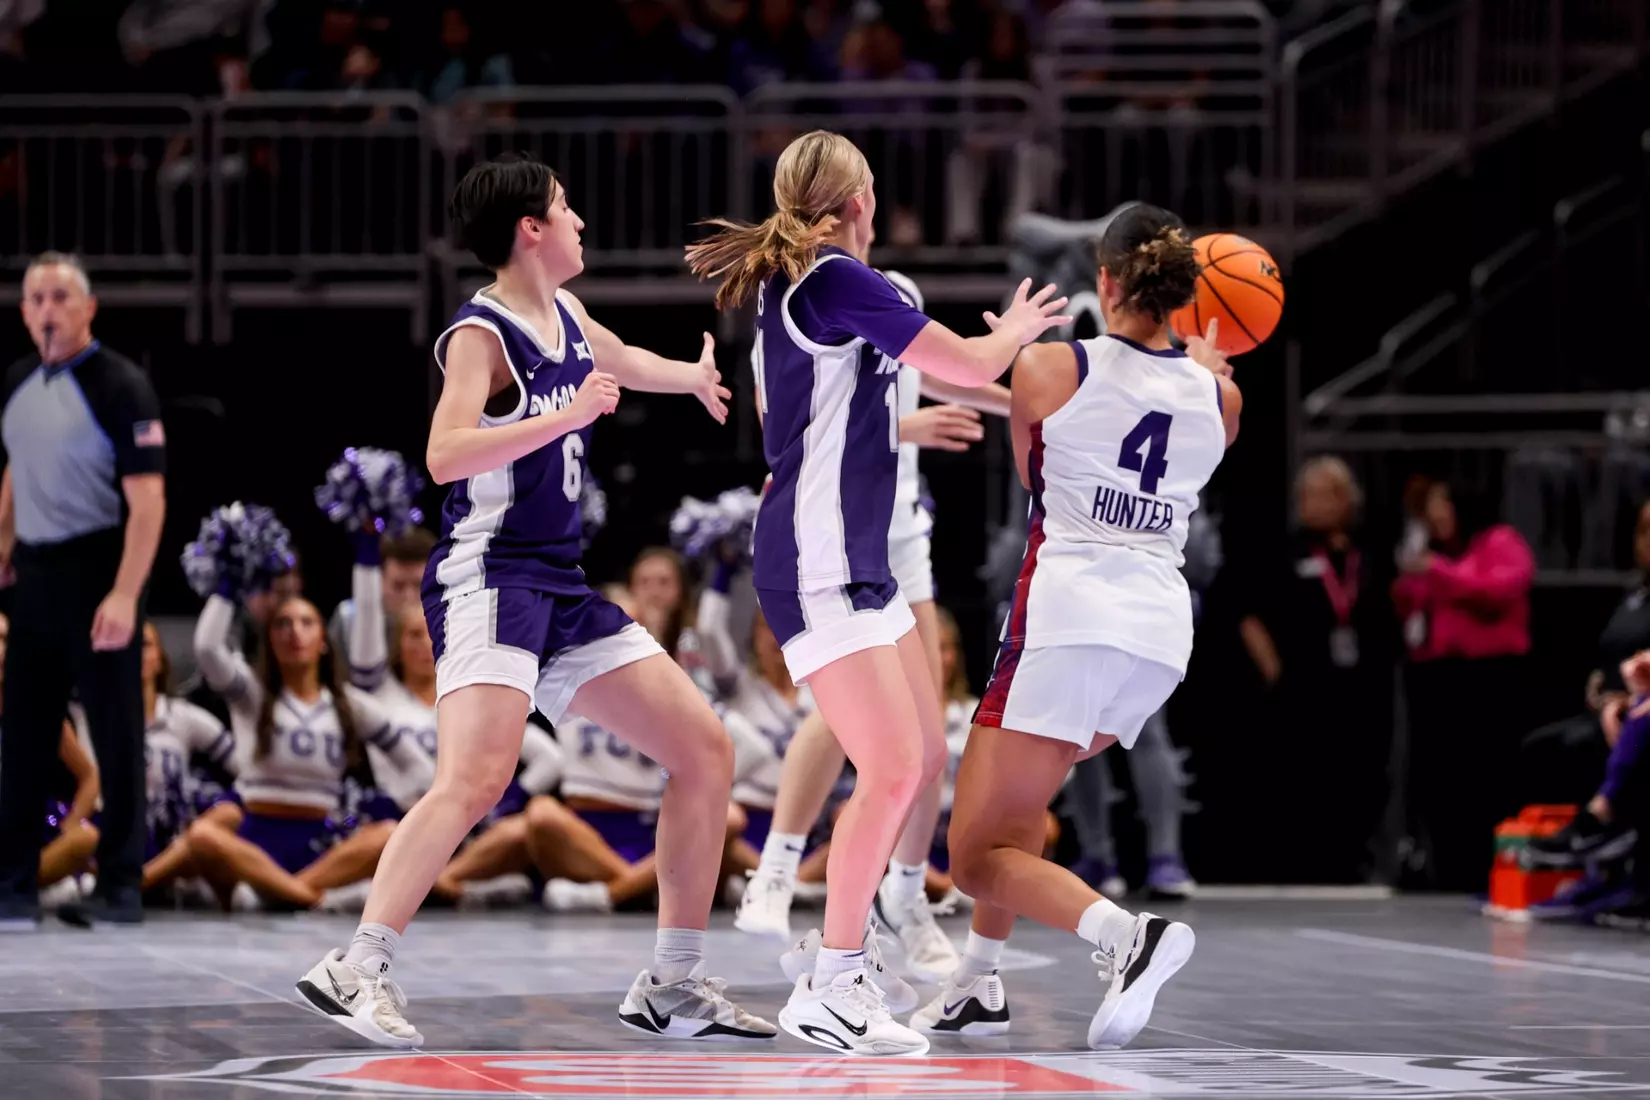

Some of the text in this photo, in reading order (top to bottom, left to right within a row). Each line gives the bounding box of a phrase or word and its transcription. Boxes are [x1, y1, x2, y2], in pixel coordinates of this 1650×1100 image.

[562, 432, 584, 502] 6
[1117, 410, 1173, 495] 4
[1091, 485, 1173, 531] HUNTER
